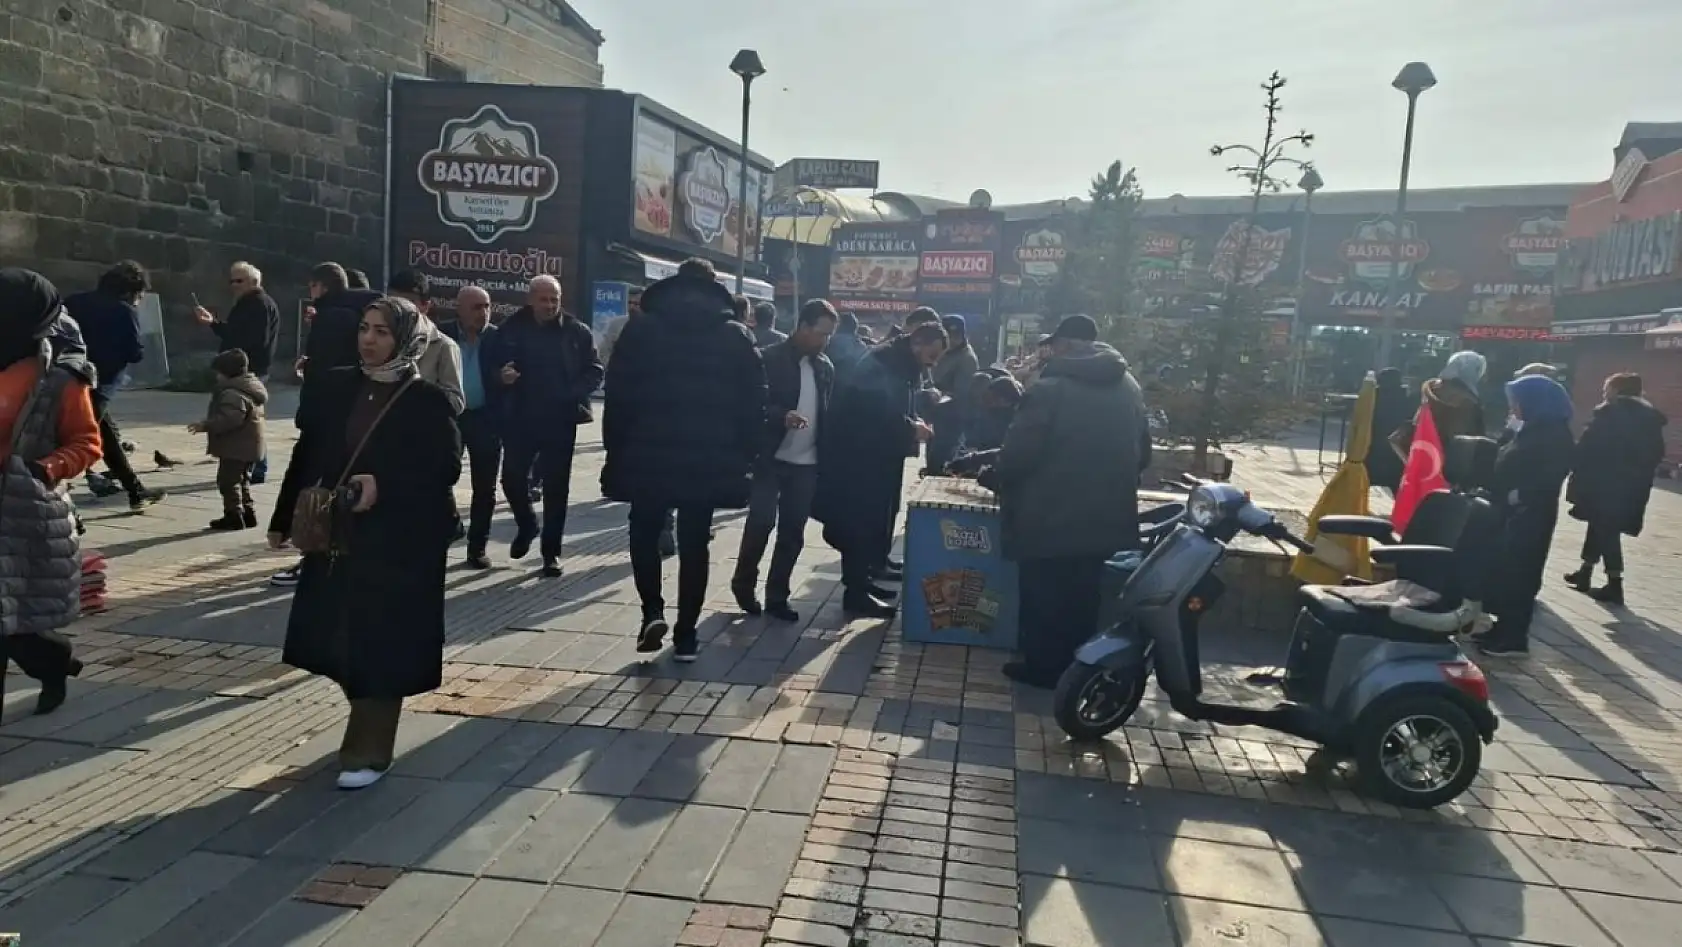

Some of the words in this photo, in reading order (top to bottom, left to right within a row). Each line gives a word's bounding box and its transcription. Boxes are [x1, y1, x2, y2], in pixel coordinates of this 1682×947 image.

[433, 160, 540, 188] BAŞYAZICI
[408, 240, 562, 281] Palamutoğlu
[923, 256, 988, 275] BAŞYAZICI
